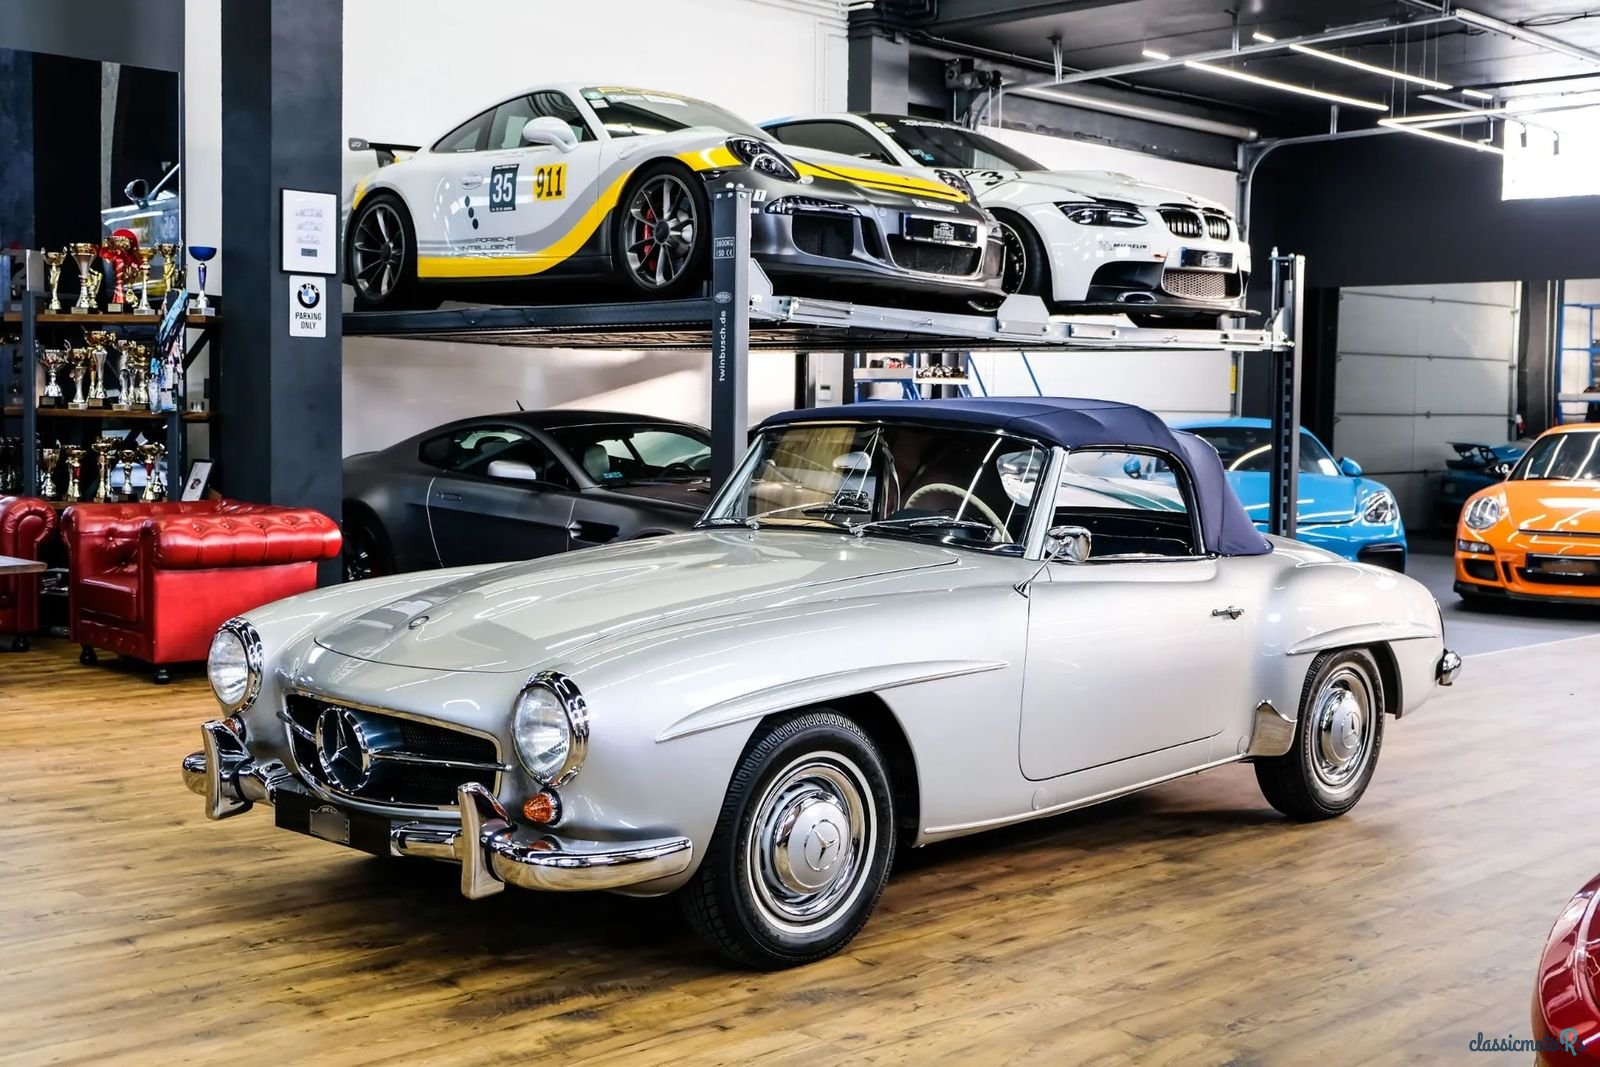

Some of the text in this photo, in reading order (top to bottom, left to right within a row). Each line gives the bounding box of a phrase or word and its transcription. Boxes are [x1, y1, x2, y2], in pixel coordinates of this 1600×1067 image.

[492, 172, 514, 203] 35
[536, 166, 562, 199] 911
[295, 312, 322, 320] PARKING
[300, 321, 316, 329] ONLY
[718, 310, 727, 382] twinbusch.de
